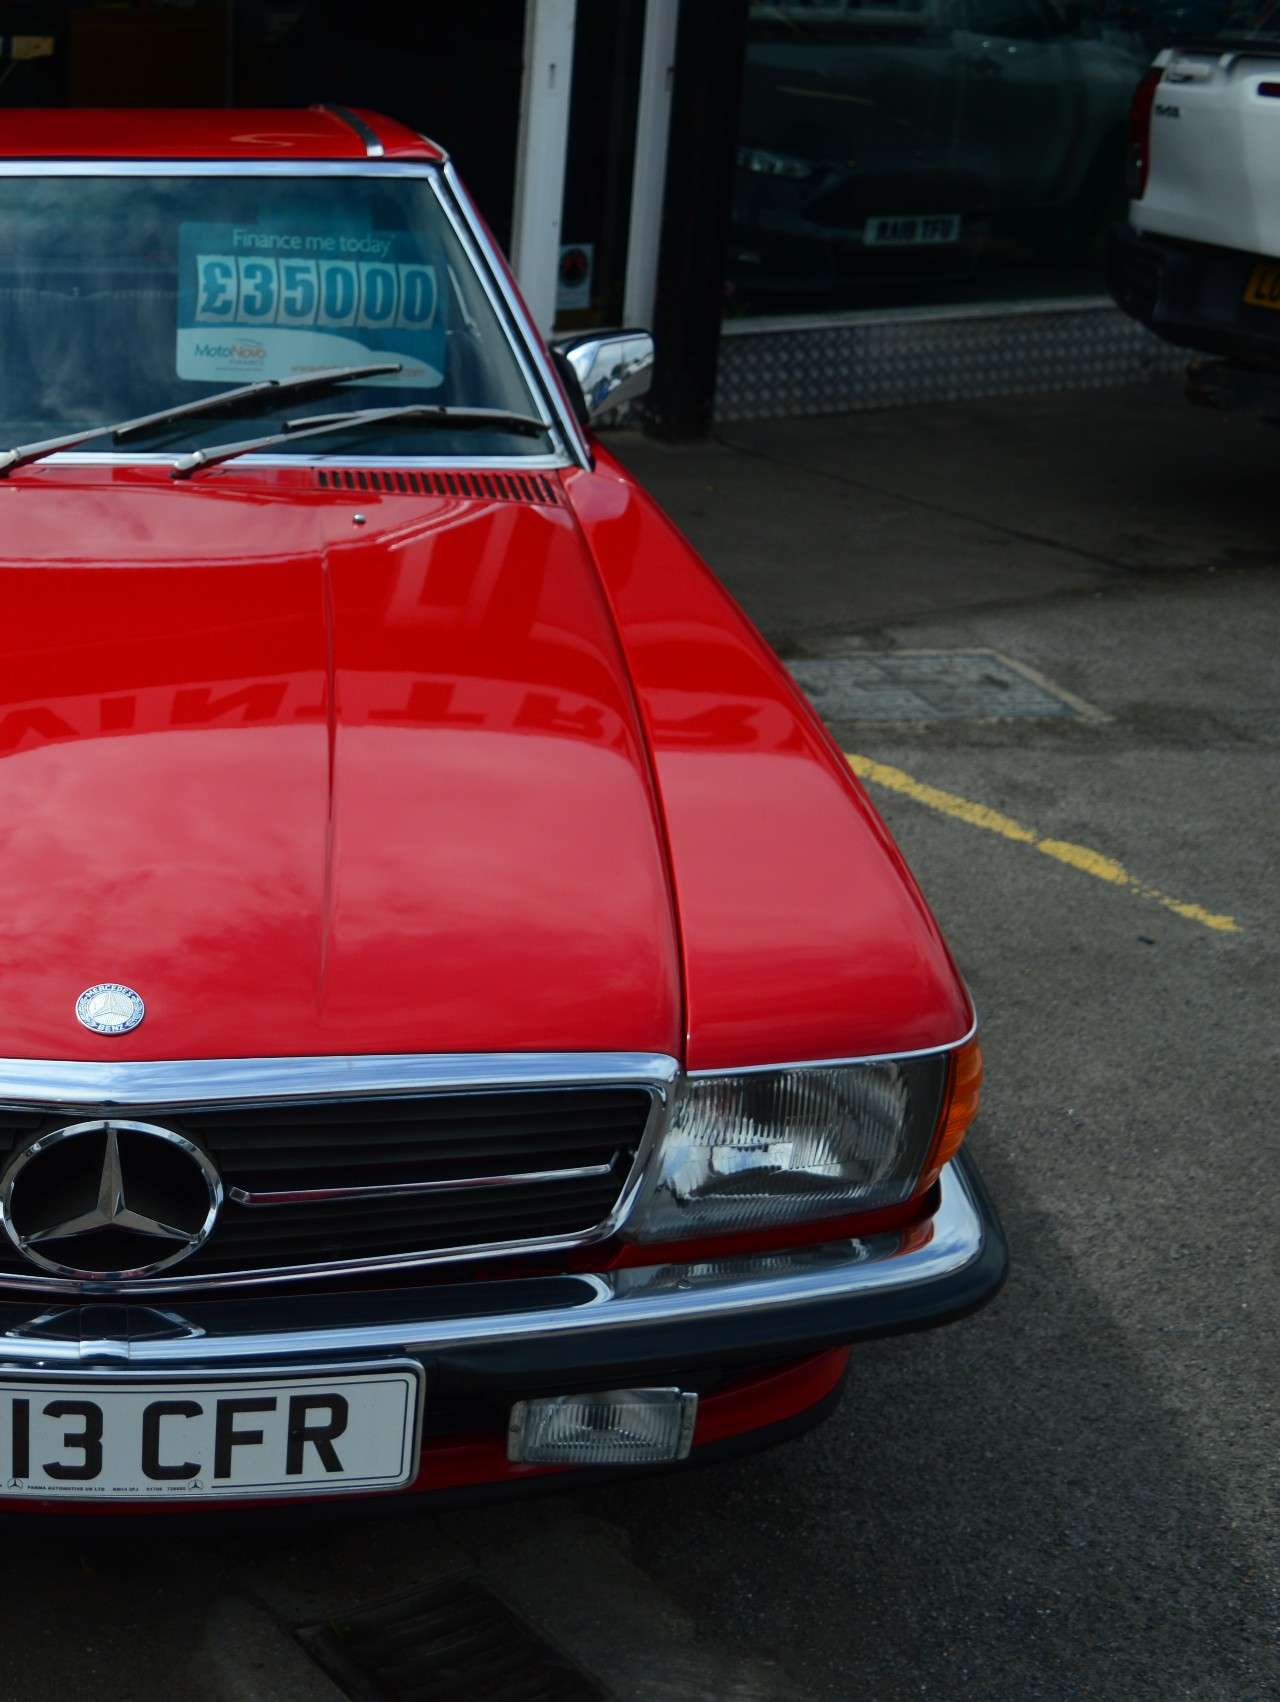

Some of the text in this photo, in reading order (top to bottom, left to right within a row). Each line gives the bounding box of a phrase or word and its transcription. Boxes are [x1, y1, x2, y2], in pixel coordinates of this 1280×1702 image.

[232, 229, 305, 249] Finance
[306, 233, 336, 251] me
[200, 261, 434, 322] £35000
[193, 343, 268, 359] MotoNovo
[85, 984, 134, 998] MERCEDES
[141, 1392, 349, 1480] CFR
